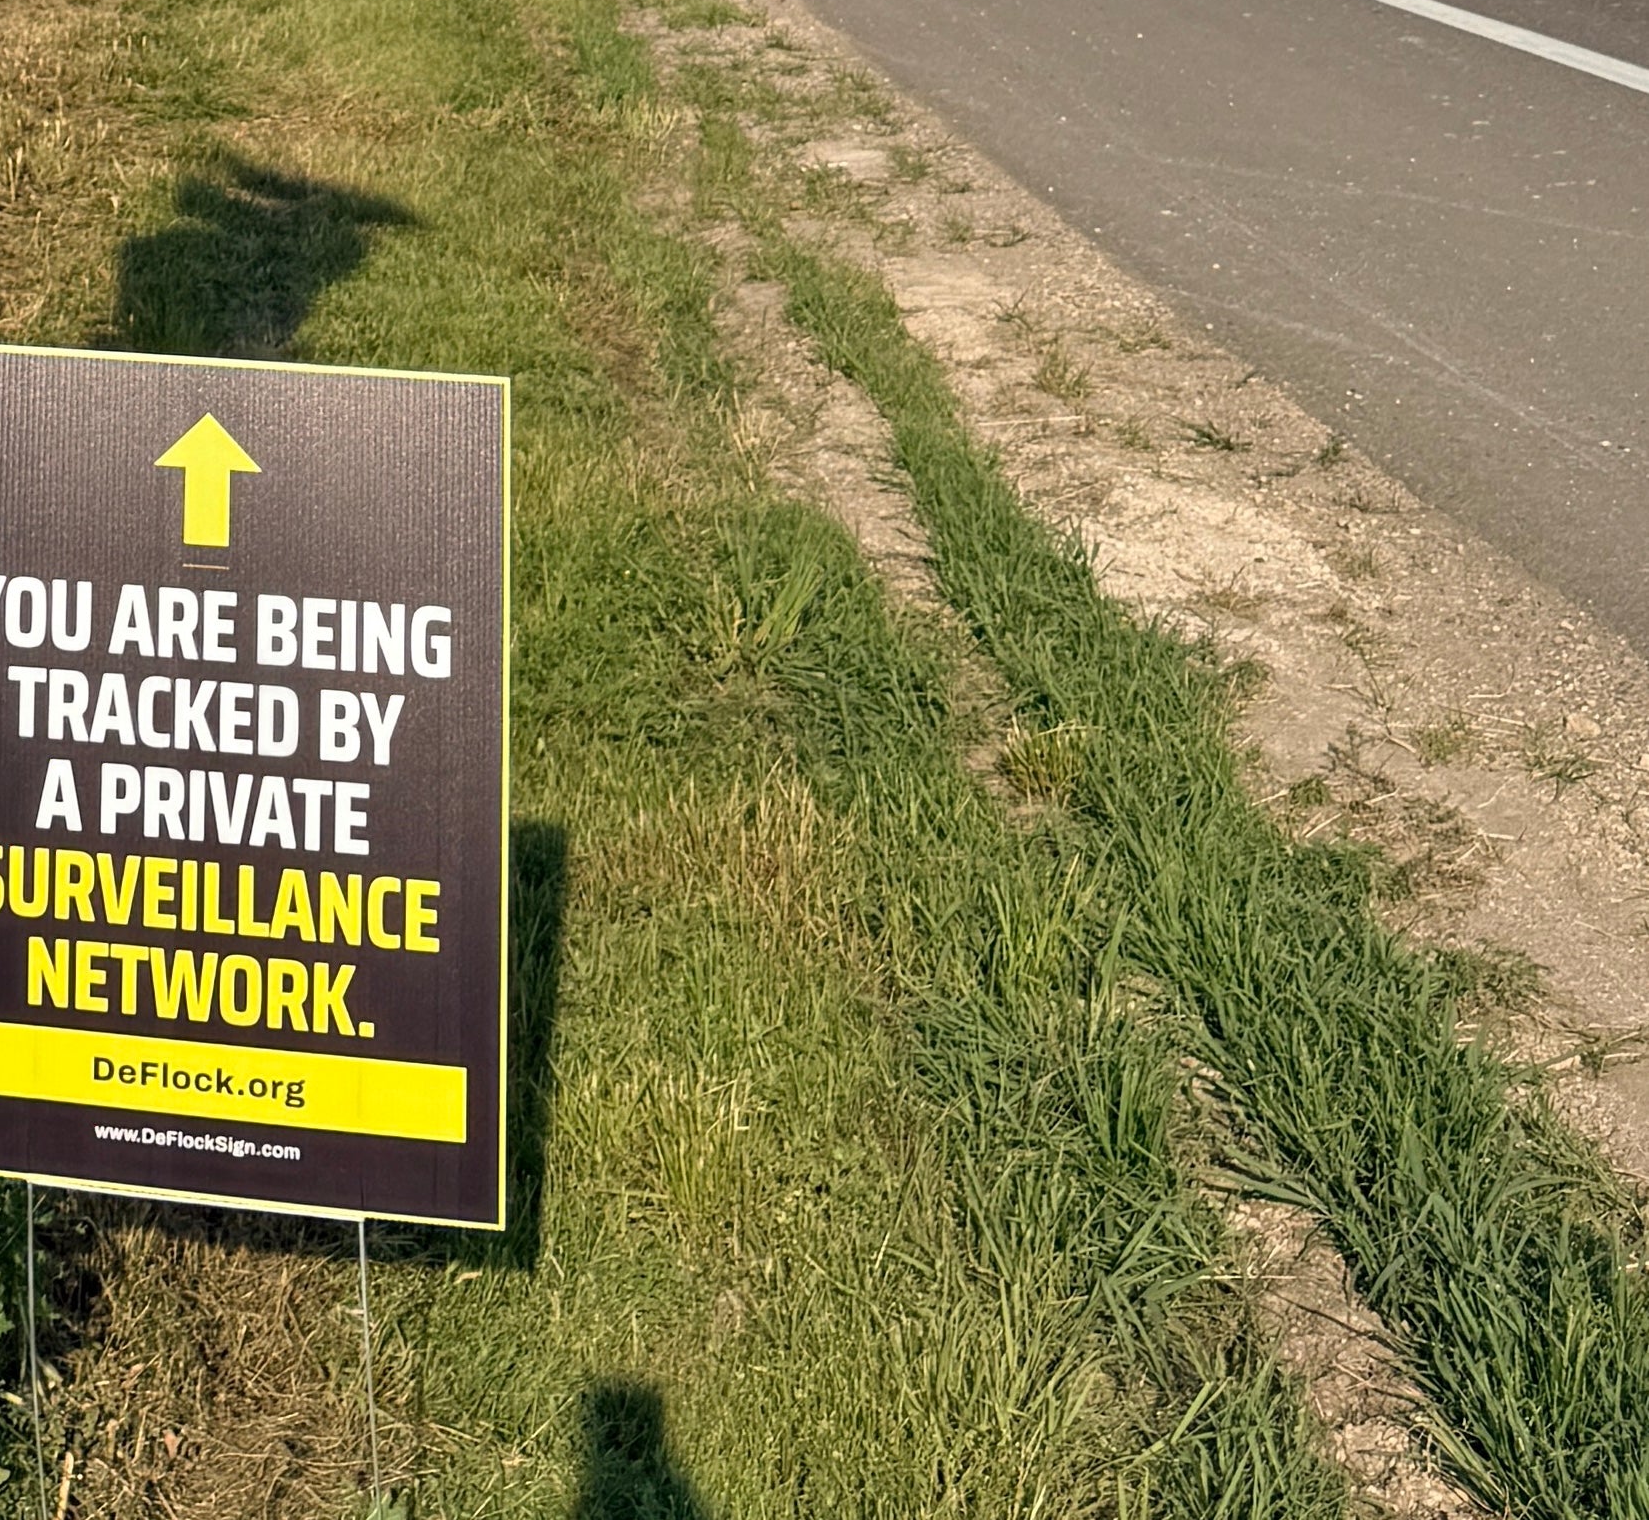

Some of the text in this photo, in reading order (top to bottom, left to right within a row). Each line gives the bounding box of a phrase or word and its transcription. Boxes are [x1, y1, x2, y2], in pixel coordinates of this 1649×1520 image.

[109, 583, 238, 663] ARE
[256, 593, 452, 679] BEING
[7, 665, 406, 766] TRACKED BY
[35, 758, 371, 856] A PRIVATE
[27, 936, 375, 1038] NETWORK.
[93, 1056, 306, 1108] DeFlock.org
[94, 1124, 301, 1161] www.DeFlockSign.com
